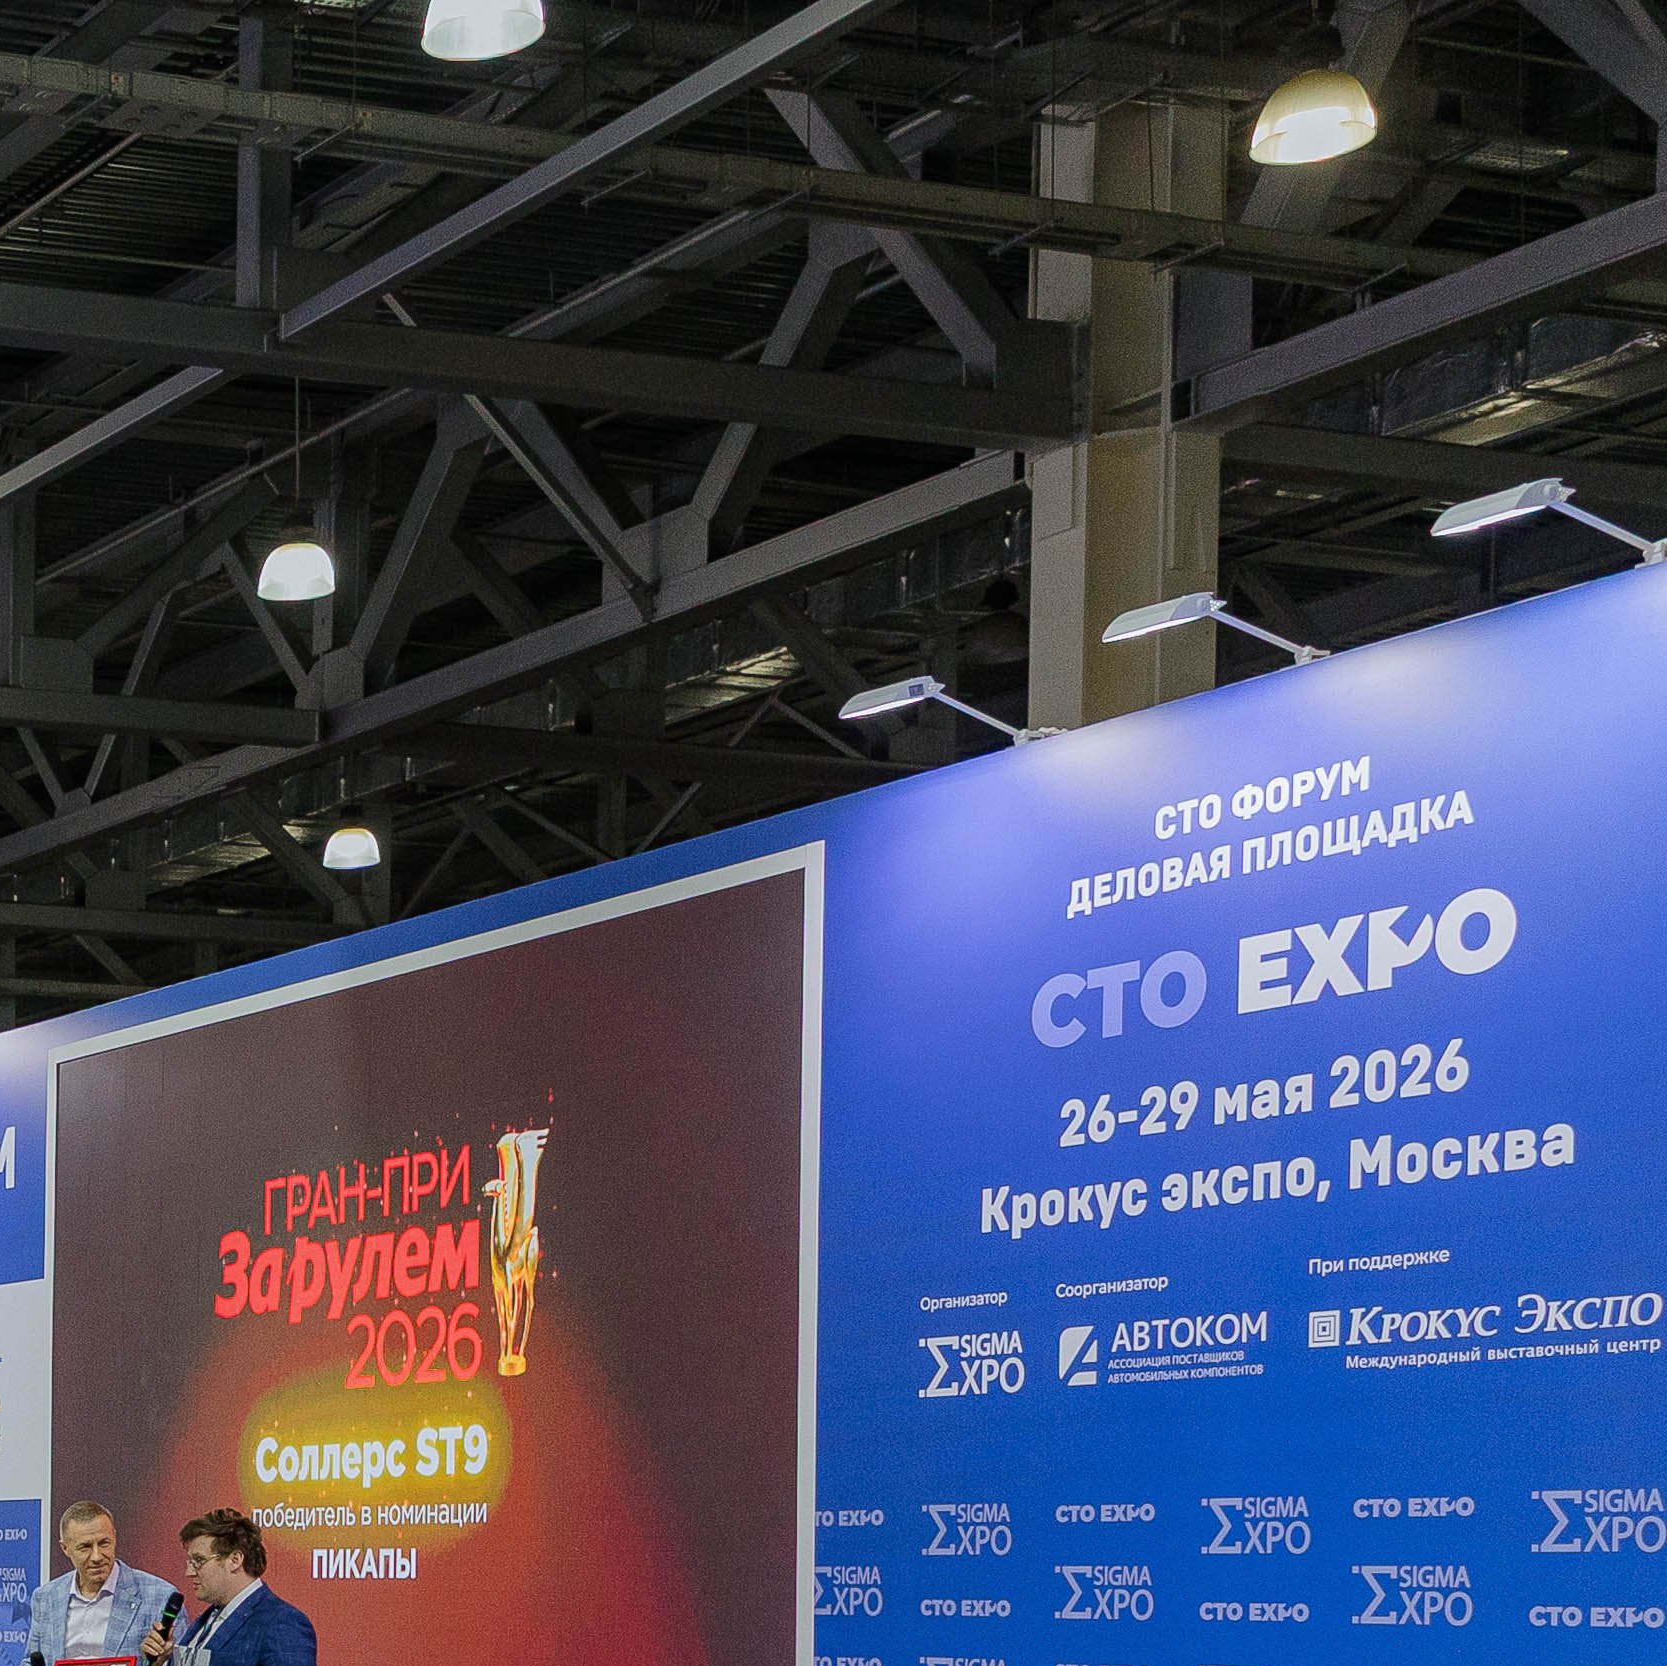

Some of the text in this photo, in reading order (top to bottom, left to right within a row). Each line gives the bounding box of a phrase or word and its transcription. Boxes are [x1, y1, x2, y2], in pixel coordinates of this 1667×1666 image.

[1154, 755, 1371, 841] СТО ФОРУМ
[1067, 789, 1475, 919] ДЕЛОВАЯ ПЛОЩАДКА
[1031, 887, 1517, 1048] СТО EXPO
[1059, 1037, 1470, 1147] 26-29 мая 2026
[264, 1143, 470, 1236] ГРАН-ПРИ
[980, 1121, 1576, 1240] Крокус экспо, Москва
[1309, 1248, 1450, 1277] При поддержке
[919, 1291, 1008, 1313] Организатор
[1055, 1275, 1169, 1300] Соорганизатор
[346, 1302, 483, 1390] 2026
[960, 1329, 1023, 1358] SIGMA
[1110, 1310, 1268, 1353] АВТОКОМ
[1108, 1350, 1245, 1370] АССОЦИАЦИЯ ПОСТАВЩИКОВ
[1345, 1337, 1661, 1371] Международный выставочный центр
[1107, 1364, 1264, 1384] АВТОМОБИЛЬНЫХ КОМПОНЕНТОВ
[255, 1423, 489, 1489] Соллерс ST9
[960, 1504, 1009, 1522] SIGMA
[1101, 1504, 1154, 1521] EXPO
[1247, 1497, 1308, 1517] SIGMA
[1409, 1497, 1474, 1516] EXPO
[1588, 1489, 1663, 1512] SIGMA
[251, 1502, 488, 1531] победитель в номинации
[312, 1547, 417, 1580] ПИКАПЫ
[1402, 1566, 1470, 1587] SIGMA
[1591, 1608, 1664, 1627] EXPO
